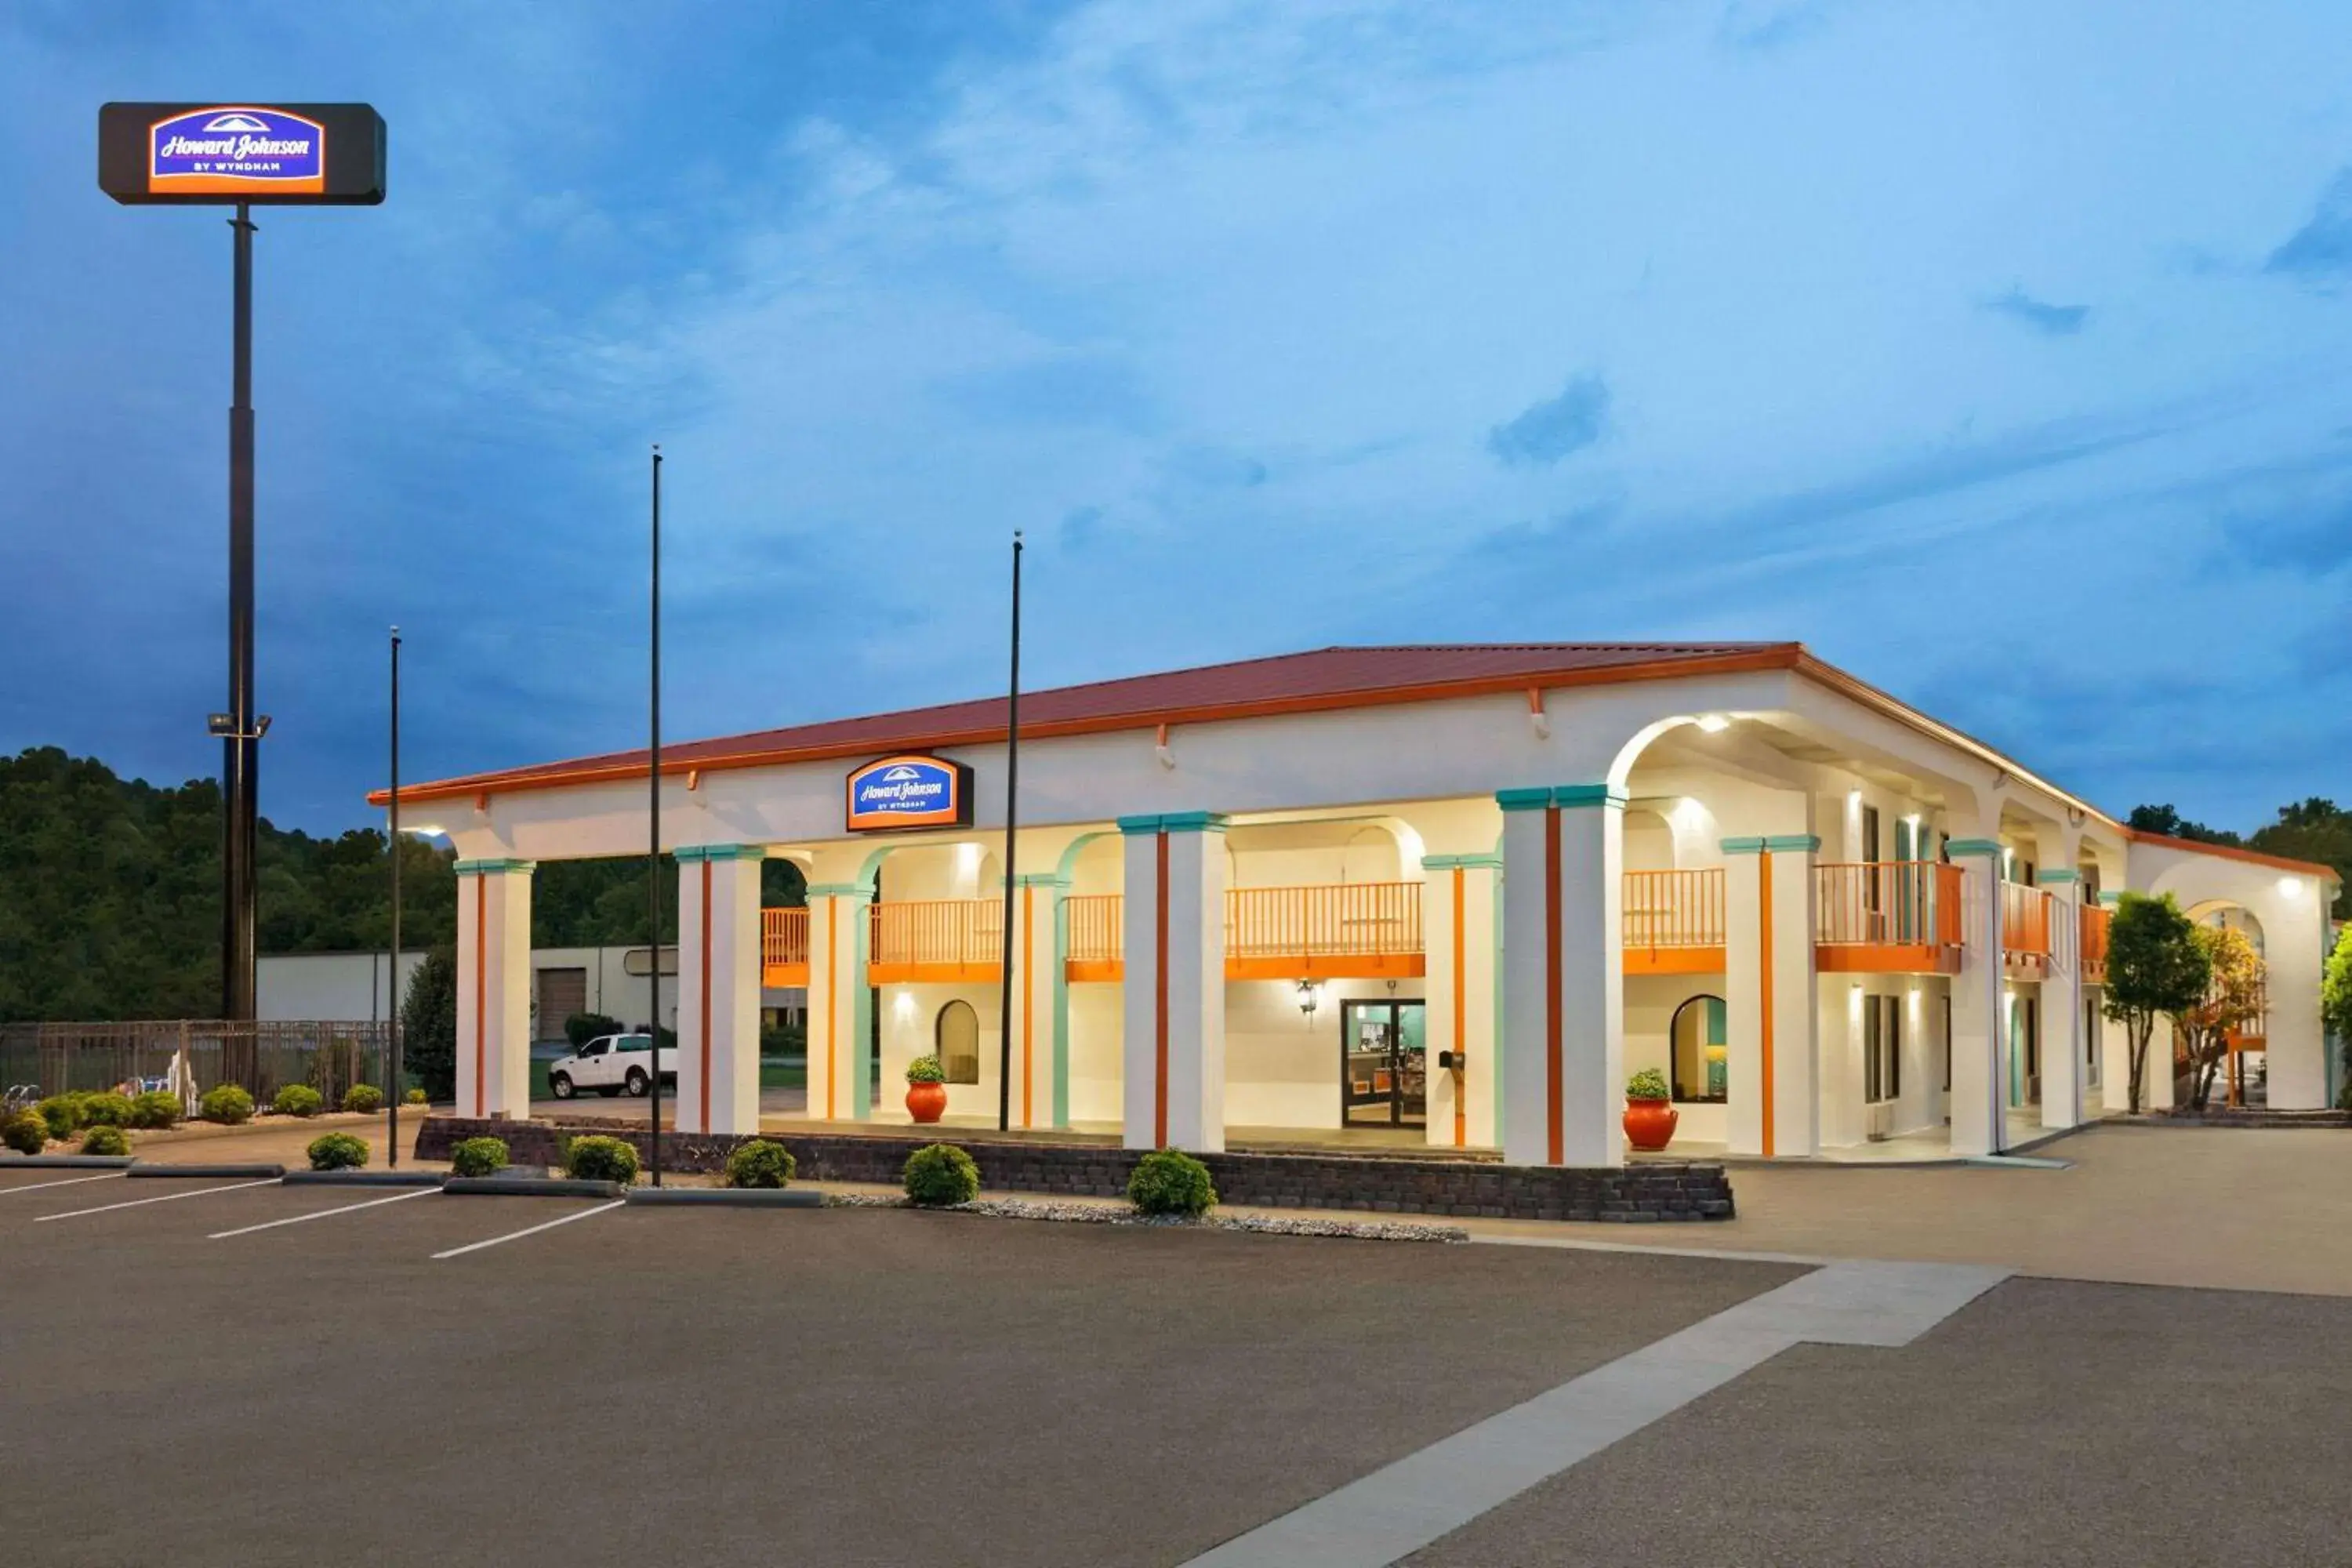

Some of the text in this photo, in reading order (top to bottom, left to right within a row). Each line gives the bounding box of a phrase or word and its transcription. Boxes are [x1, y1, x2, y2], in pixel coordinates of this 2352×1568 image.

[162, 134, 310, 160] Howard Johnson
[194, 162, 281, 171] BY WYNDHAM
[861, 782, 942, 801] Howard Johnson
